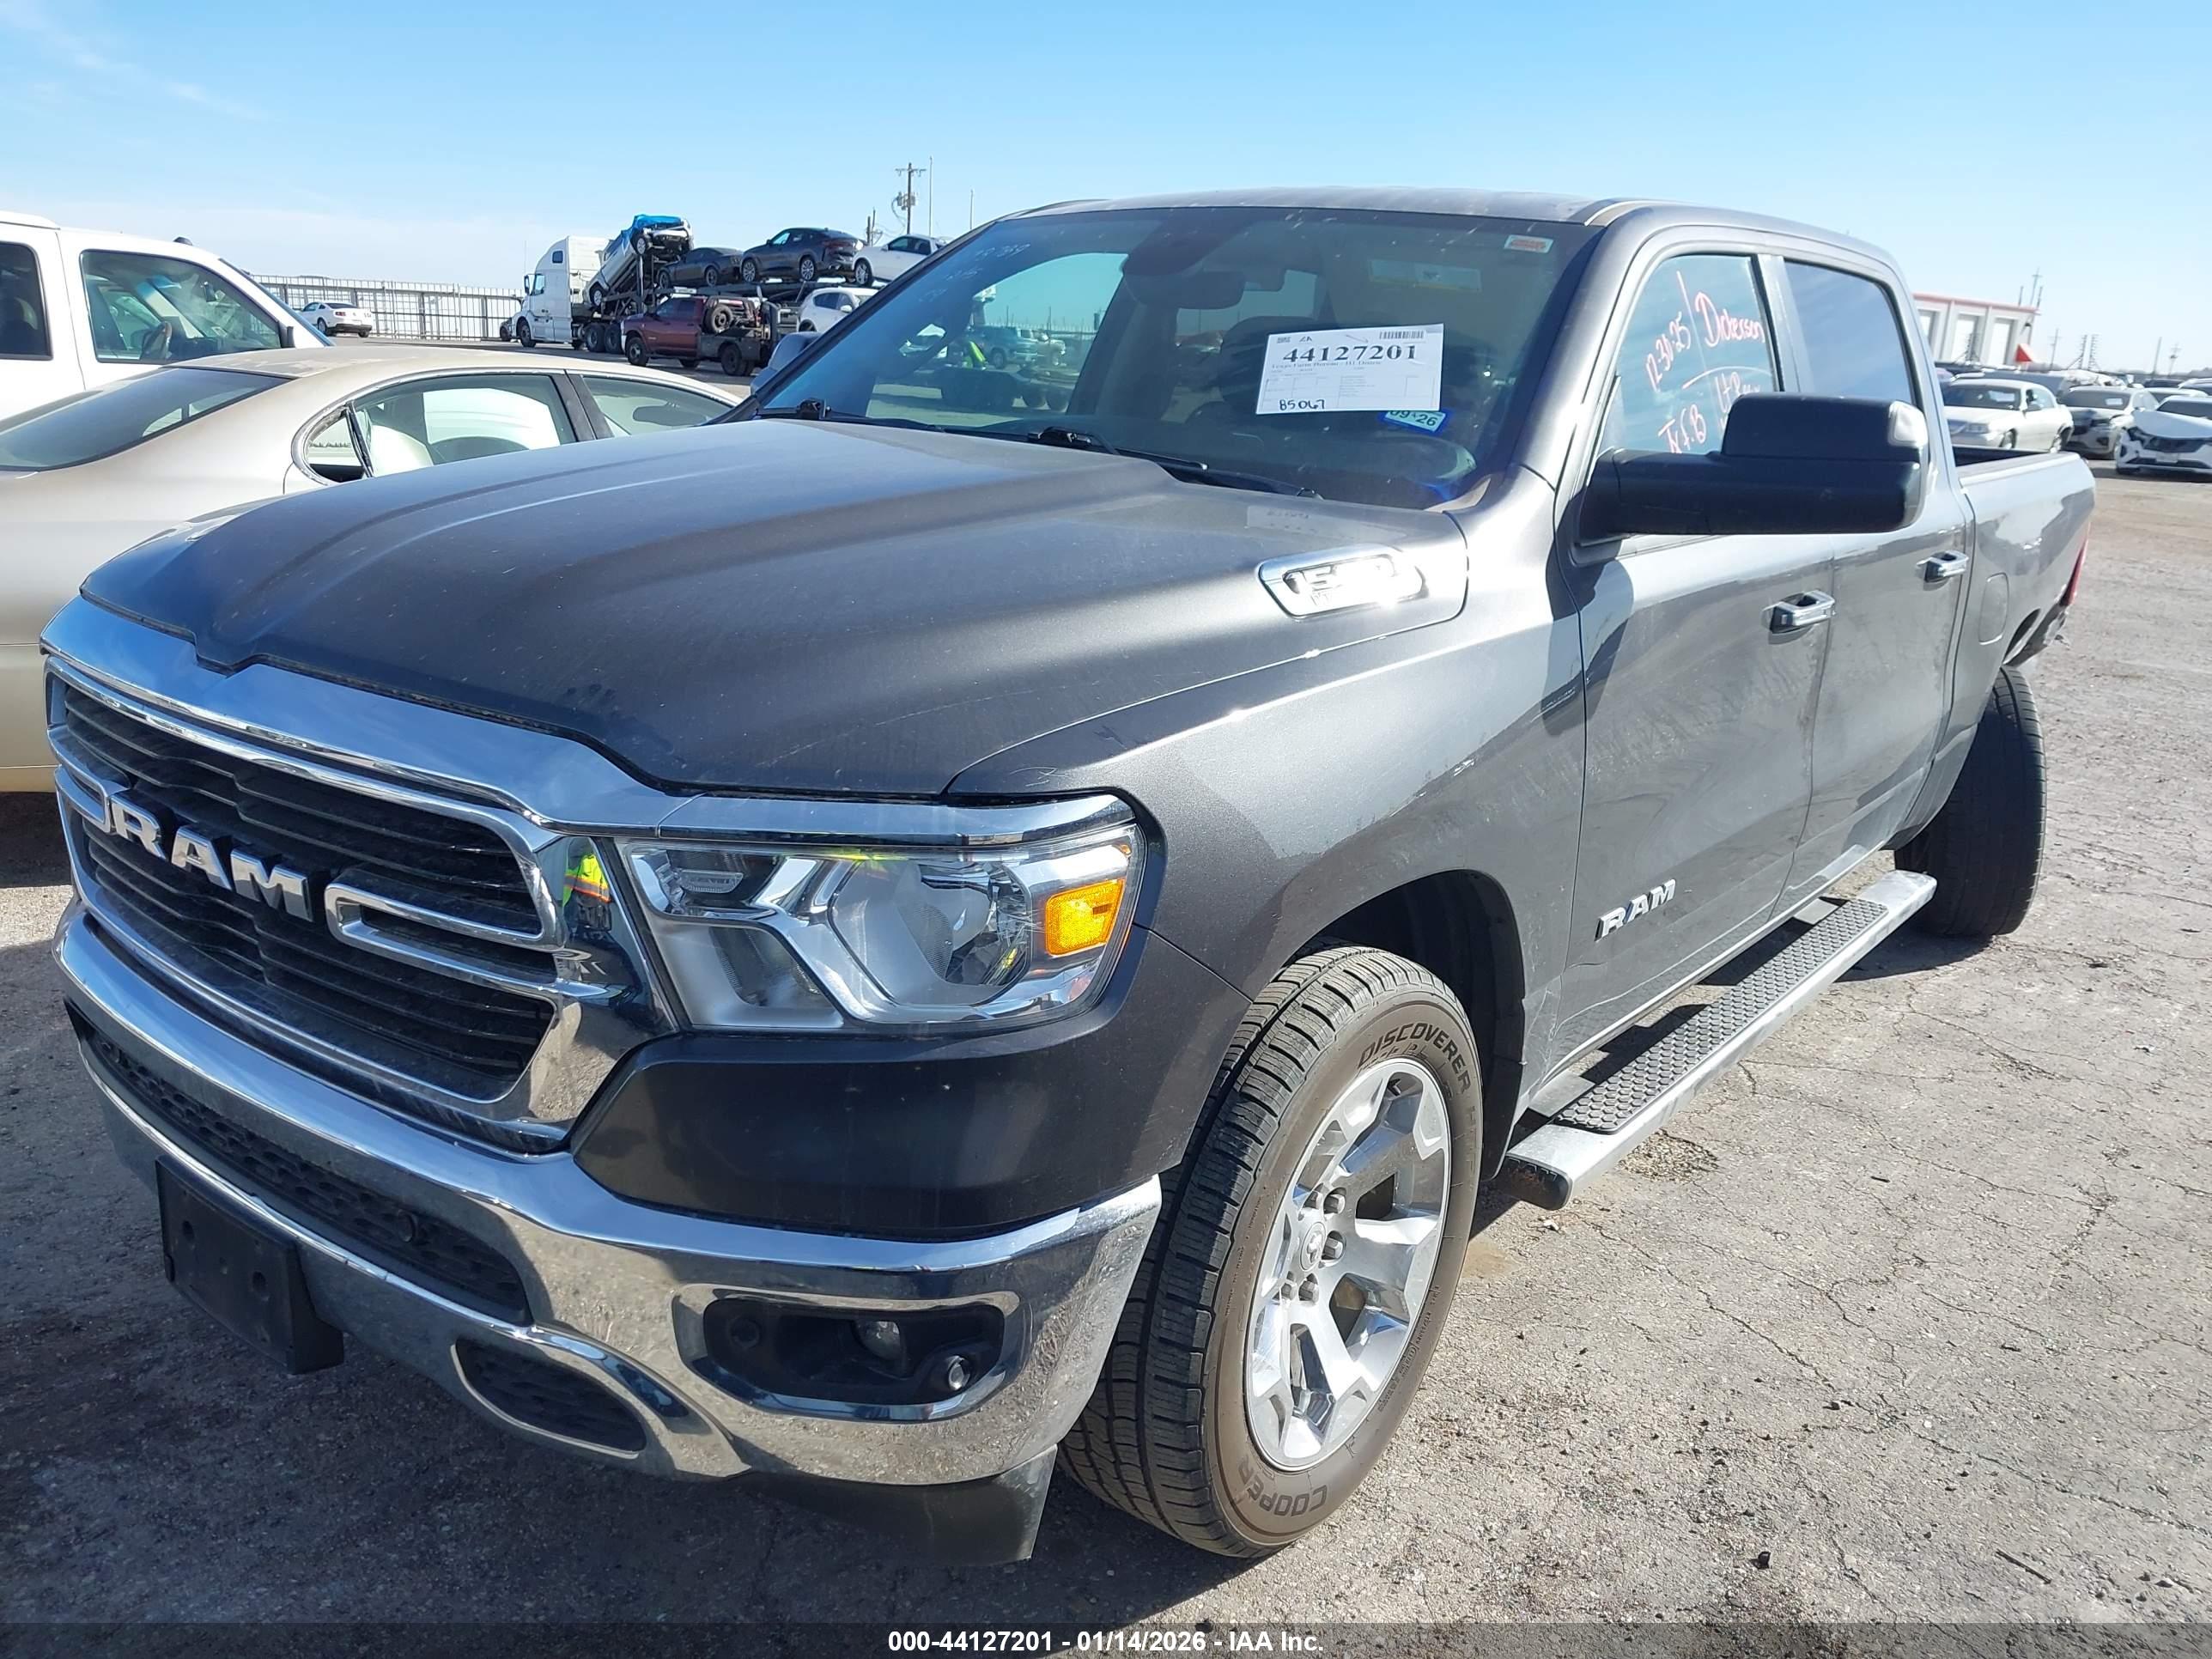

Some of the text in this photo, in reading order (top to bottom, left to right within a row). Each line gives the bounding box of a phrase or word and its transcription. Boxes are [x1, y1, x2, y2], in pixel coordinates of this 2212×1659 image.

[1283, 344, 1416, 362] 44127201
[1415, 414, 1438, 426] 26
[110, 793, 313, 921] RAM
[1595, 878, 1676, 942] RAM
[1357, 1023, 1471, 1094] DISCOVERER
[1237, 1460, 1328, 1516] COOPER
